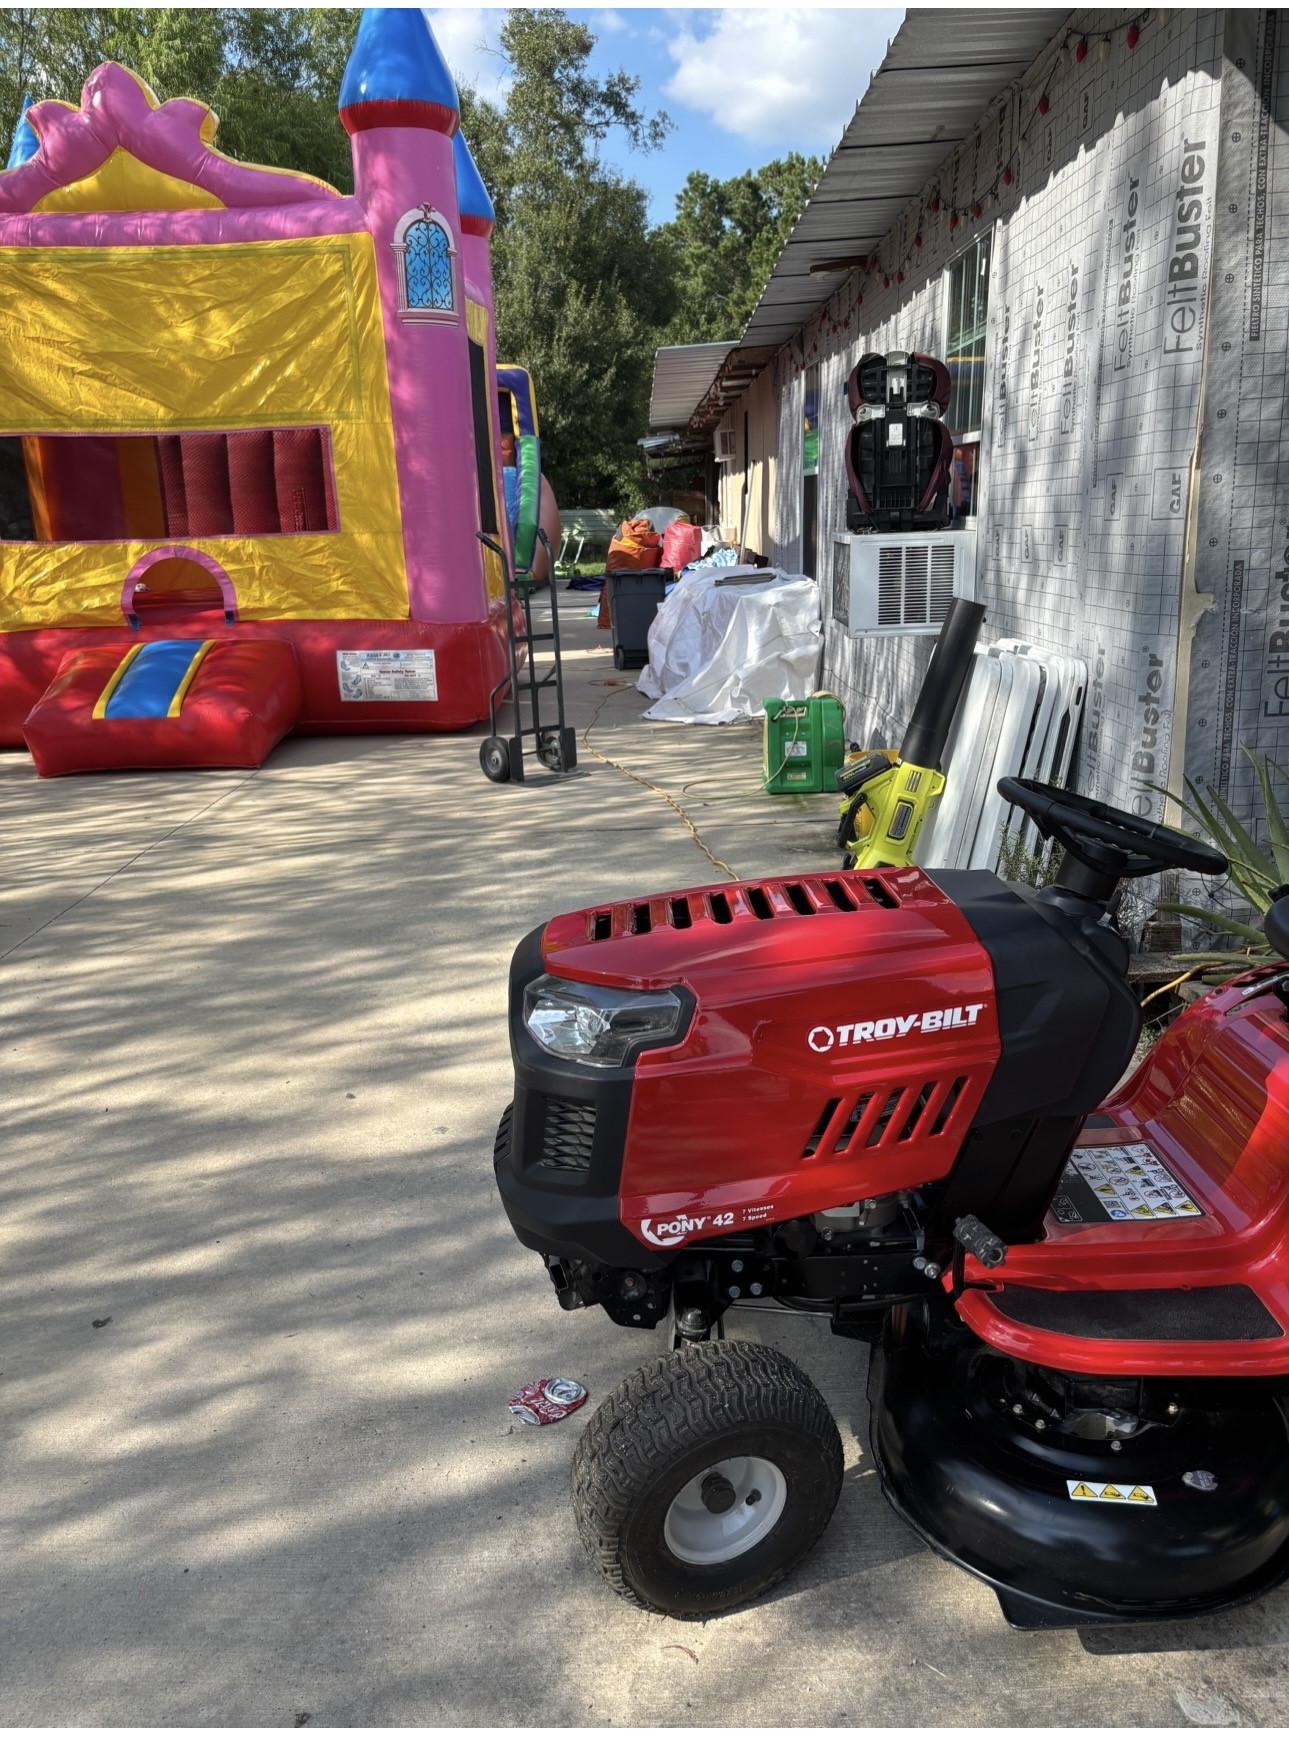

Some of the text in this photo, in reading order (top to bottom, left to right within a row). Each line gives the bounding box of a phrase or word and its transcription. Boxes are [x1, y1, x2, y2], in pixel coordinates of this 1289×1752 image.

[1263, 14, 1276, 85] INCORPORADA
[1257, 169, 1267, 190] CON
[1163, 137, 1207, 355] FeltBuster
[1253, 232, 1264, 255] PARA
[1114, 175, 1140, 372] FeltBuster
[1250, 304, 1260, 338] FIELTRO
[1060, 263, 1079, 436] FeltBuster
[1109, 478, 1118, 516] GAF
[1169, 473, 1182, 514] GAF
[1232, 563, 1243, 621] INCORPORADA
[1226, 689, 1234, 707] CON
[1129, 653, 1164, 818] eltBuster
[1222, 743, 1231, 762] PARA
[836, 1003, 984, 1046] TROY-BILT
[657, 1212, 735, 1236] PONY 42
[747, 1213, 767, 1222] Speed
